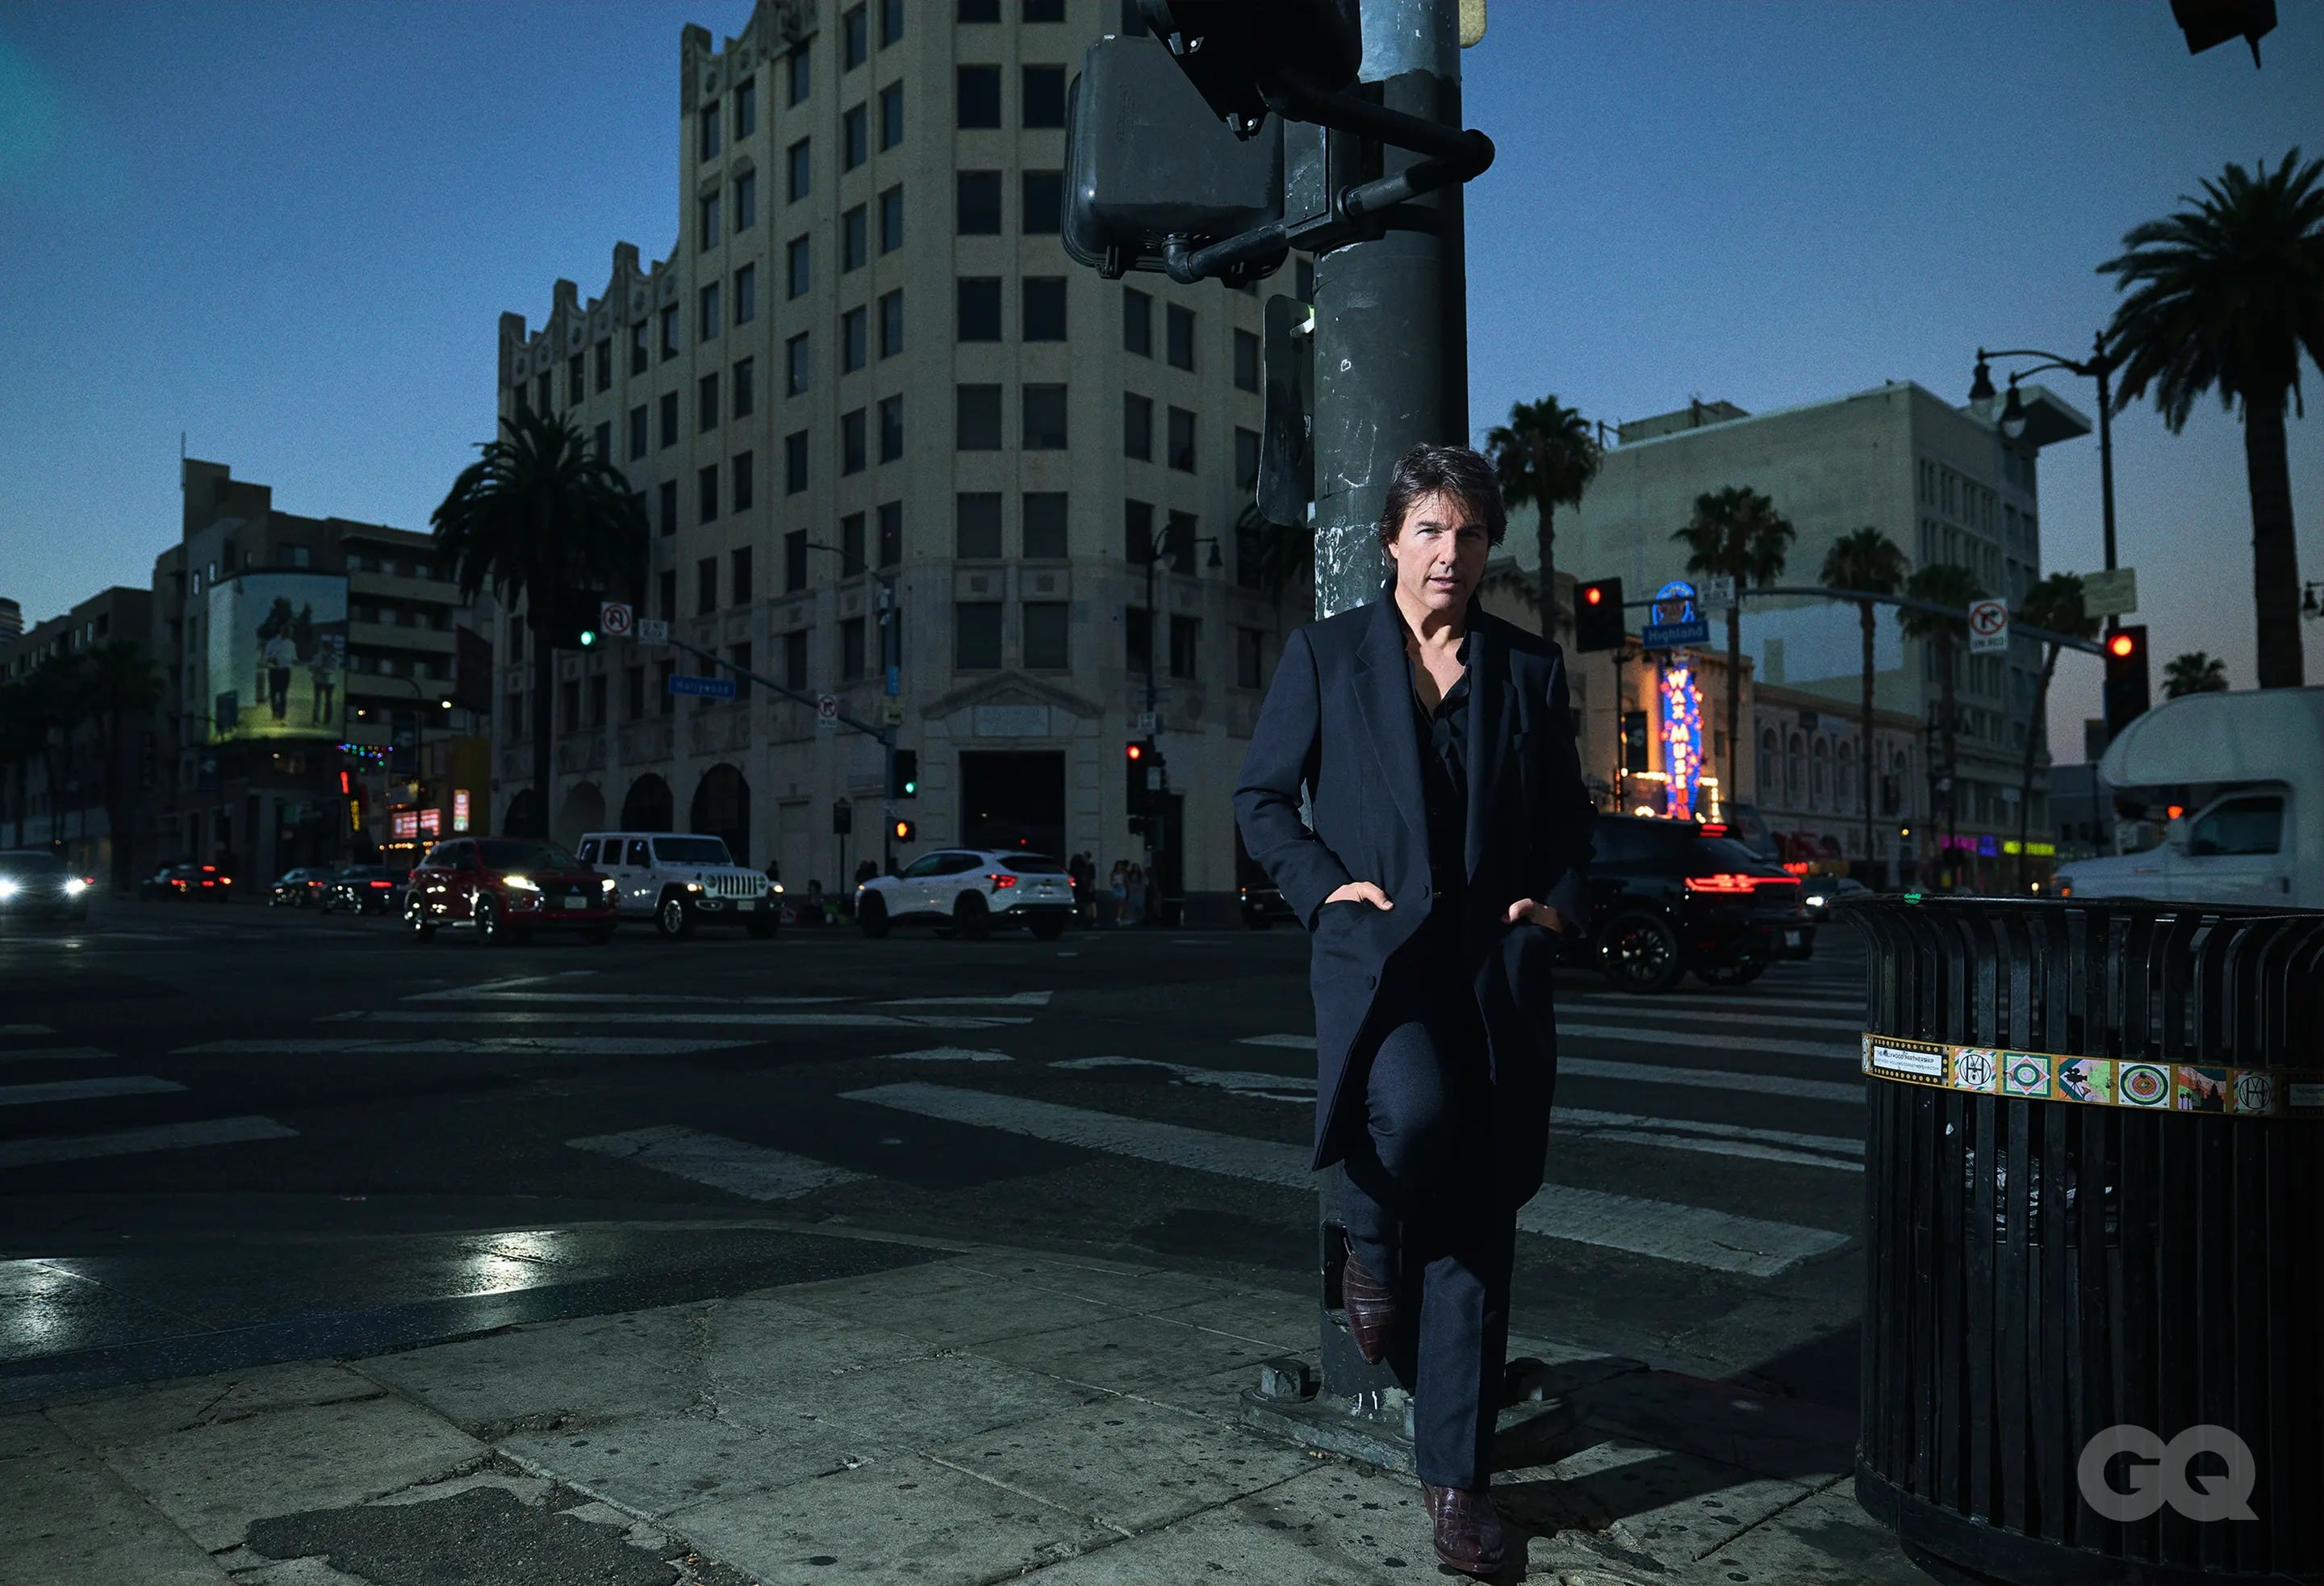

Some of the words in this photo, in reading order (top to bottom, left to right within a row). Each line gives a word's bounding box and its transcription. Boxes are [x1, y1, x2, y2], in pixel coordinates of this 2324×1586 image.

[1649, 626, 1704, 645] Highland
[675, 677, 729, 696] Hollywood
[1668, 669, 1689, 720] WAX
